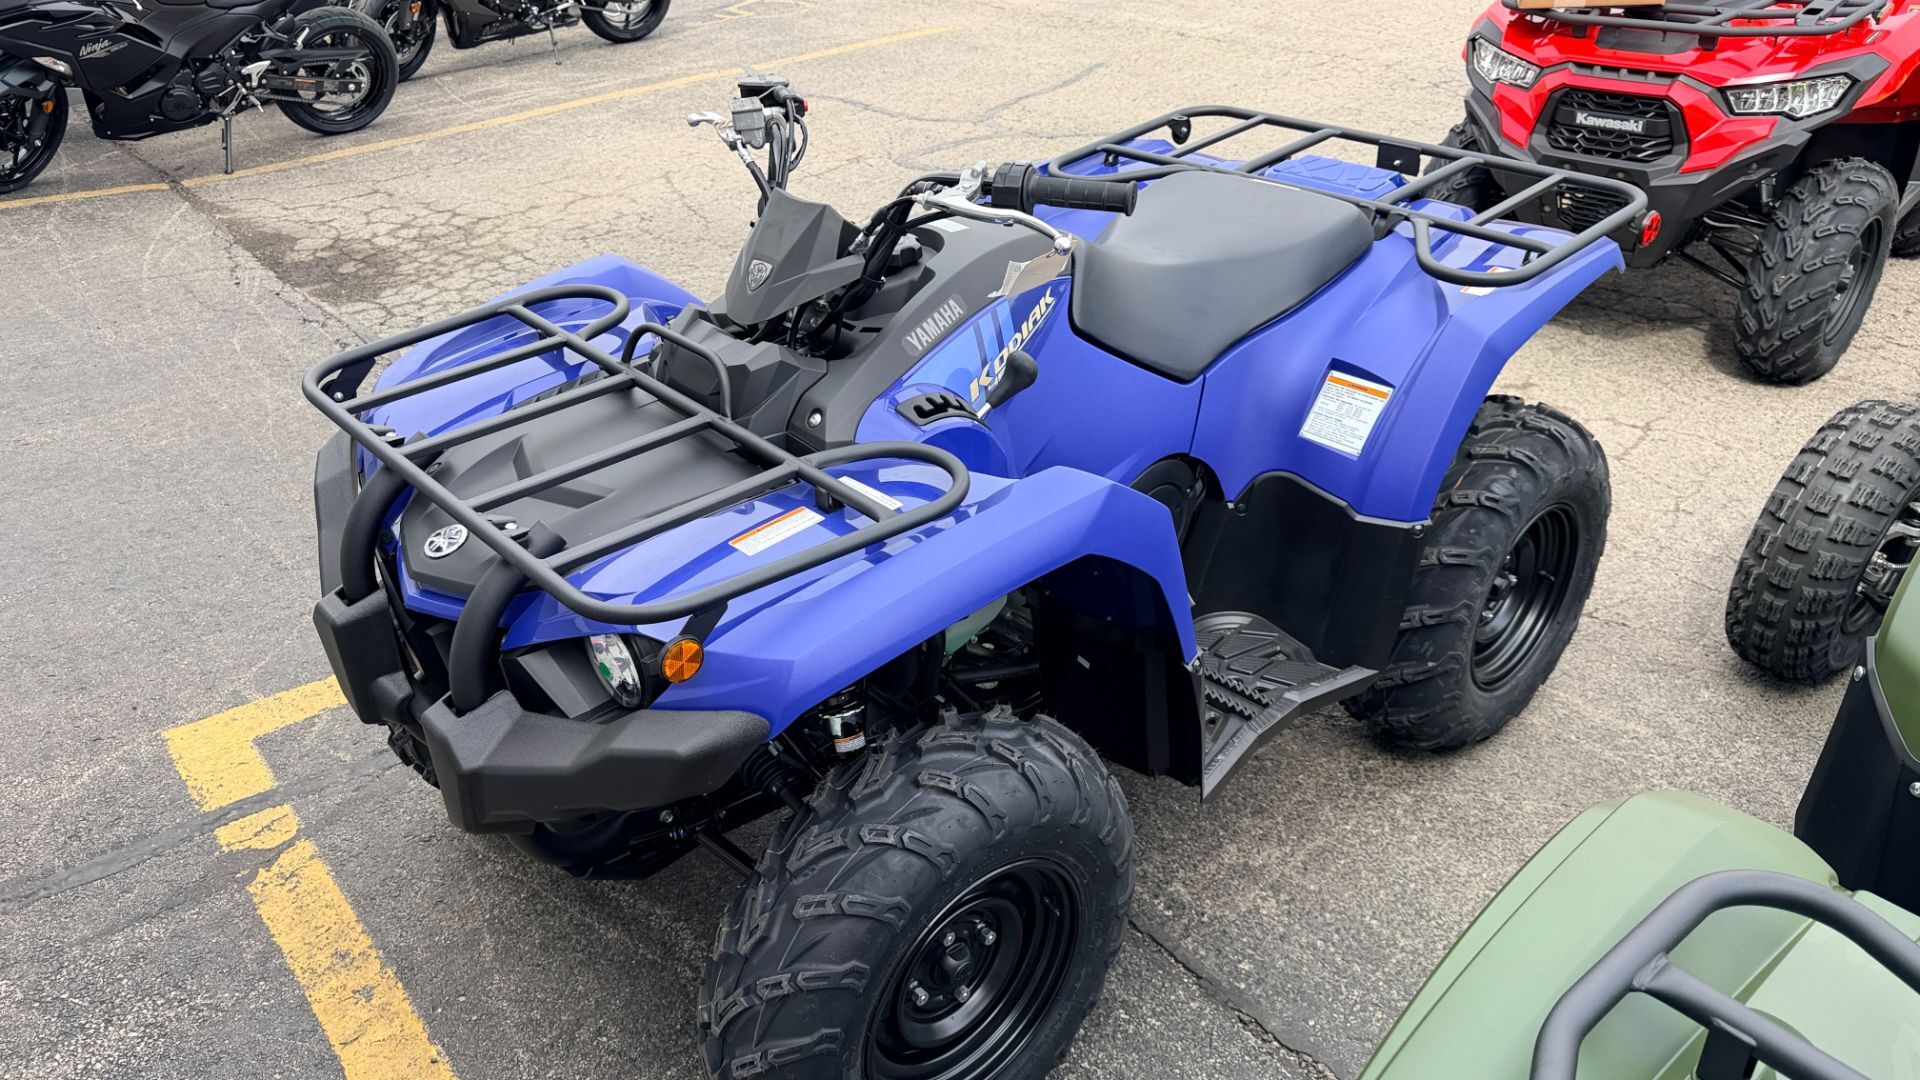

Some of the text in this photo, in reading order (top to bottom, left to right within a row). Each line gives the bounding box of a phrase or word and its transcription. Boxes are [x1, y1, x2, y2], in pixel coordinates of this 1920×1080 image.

[79, 37, 112, 56] Ninja
[1576, 112, 1643, 132] Kawasaki
[906, 299, 964, 351] YAMAHA
[969, 286, 1056, 402] KODIAK
